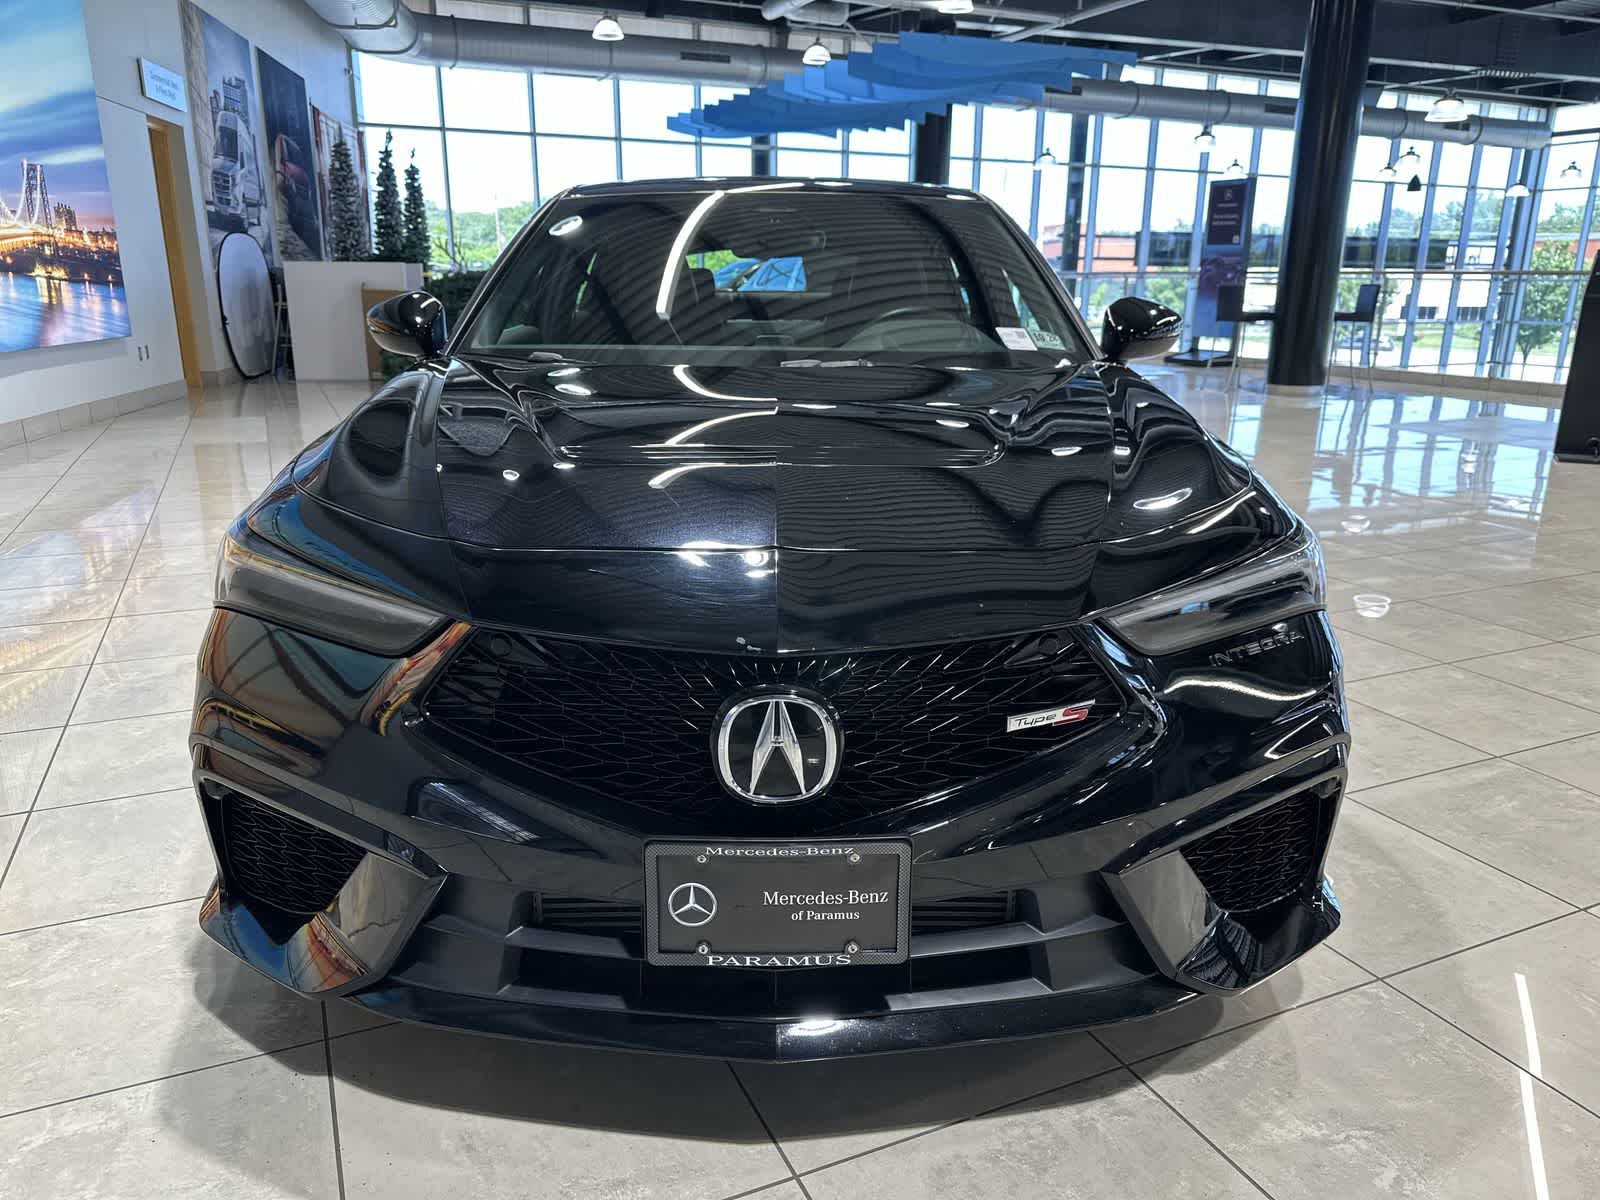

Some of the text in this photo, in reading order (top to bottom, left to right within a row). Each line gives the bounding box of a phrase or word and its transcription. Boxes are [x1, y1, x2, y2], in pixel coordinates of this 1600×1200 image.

[1208, 631, 1305, 667] INTEGRA
[1014, 706, 1089, 727] Type S
[705, 847, 854, 856] Mercedes-Benz
[762, 890, 889, 906] Mercedes-Benz
[791, 910, 860, 921] of Paramus
[706, 954, 851, 966] PARAMUS
